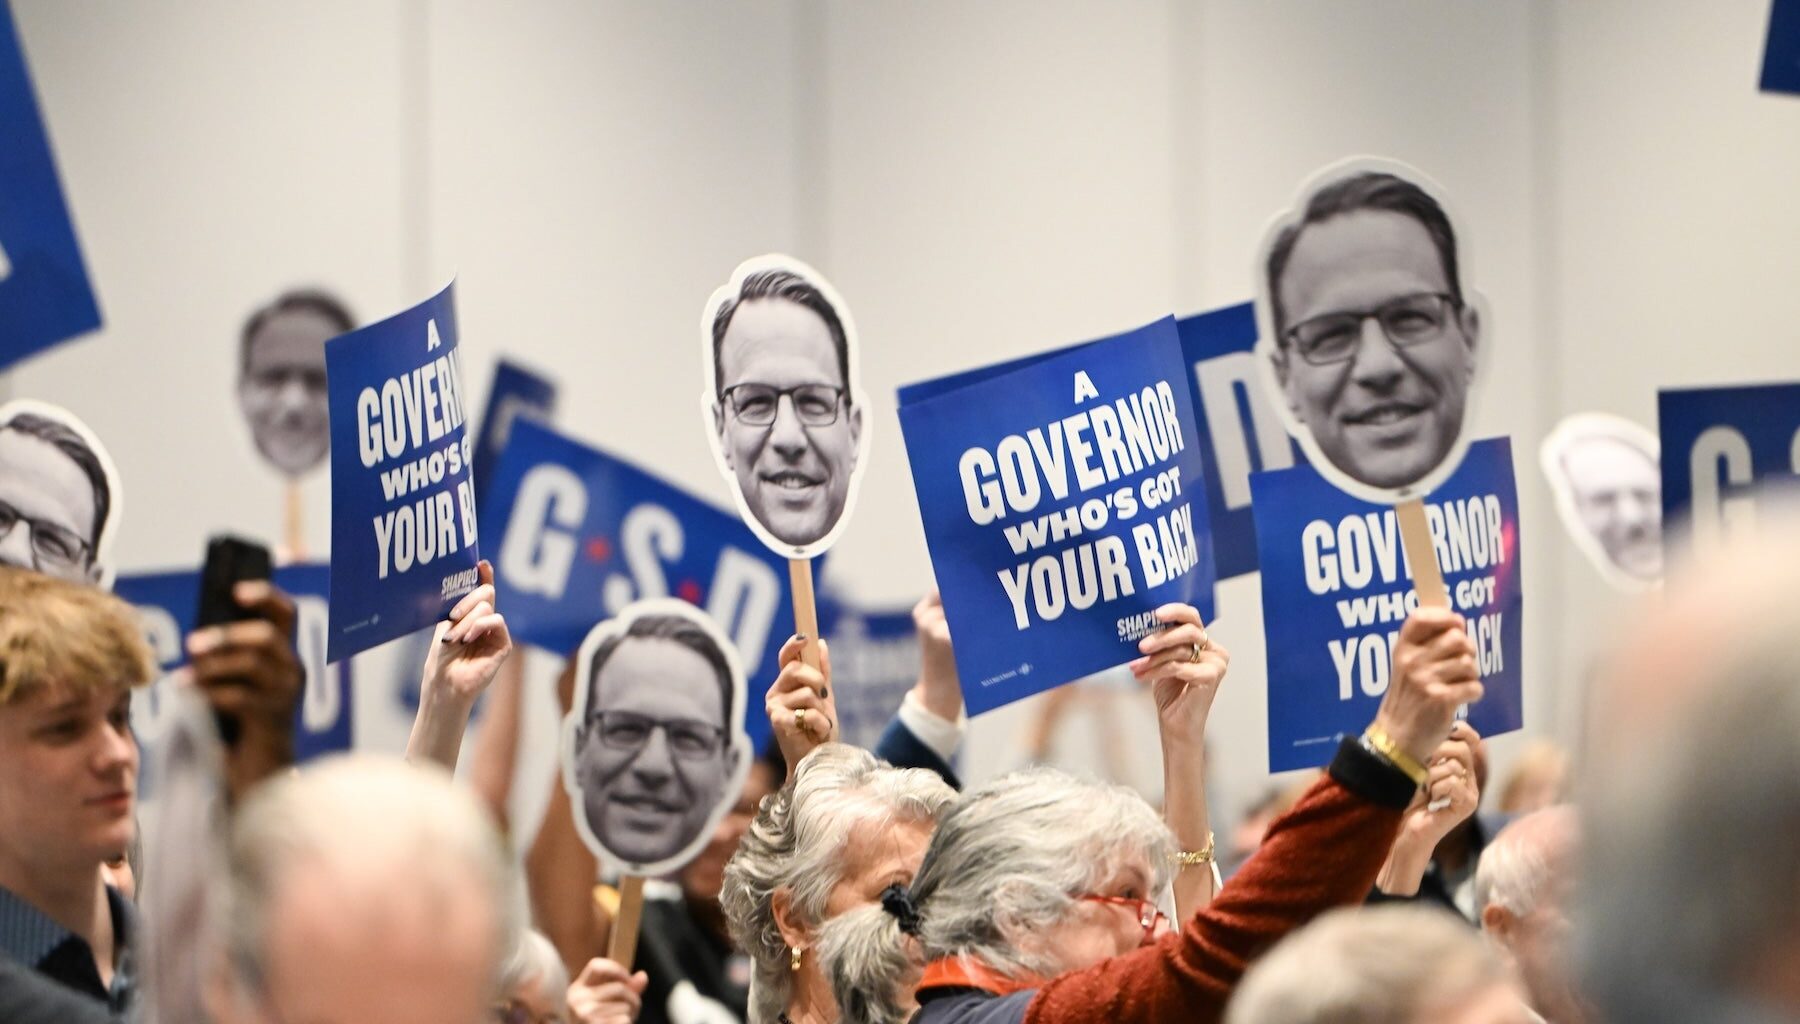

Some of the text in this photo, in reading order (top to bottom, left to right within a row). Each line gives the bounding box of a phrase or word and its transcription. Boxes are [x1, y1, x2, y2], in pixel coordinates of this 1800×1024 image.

[427, 319, 441, 352] A
[1074, 370, 1099, 404] A
[380, 442, 462, 501] WHO'S
[958, 380, 1185, 526] GOVERNOR
[373, 490, 458, 580] YOUR
[1003, 466, 1182, 555] WHO'S GOT
[441, 566, 478, 596] SHAPIRO
[997, 502, 1199, 631] YOUR BACK
[1117, 609, 1160, 636] SHAPI
[1336, 576, 1496, 629] WHO GOT
[1328, 612, 1503, 700] YO ACK
